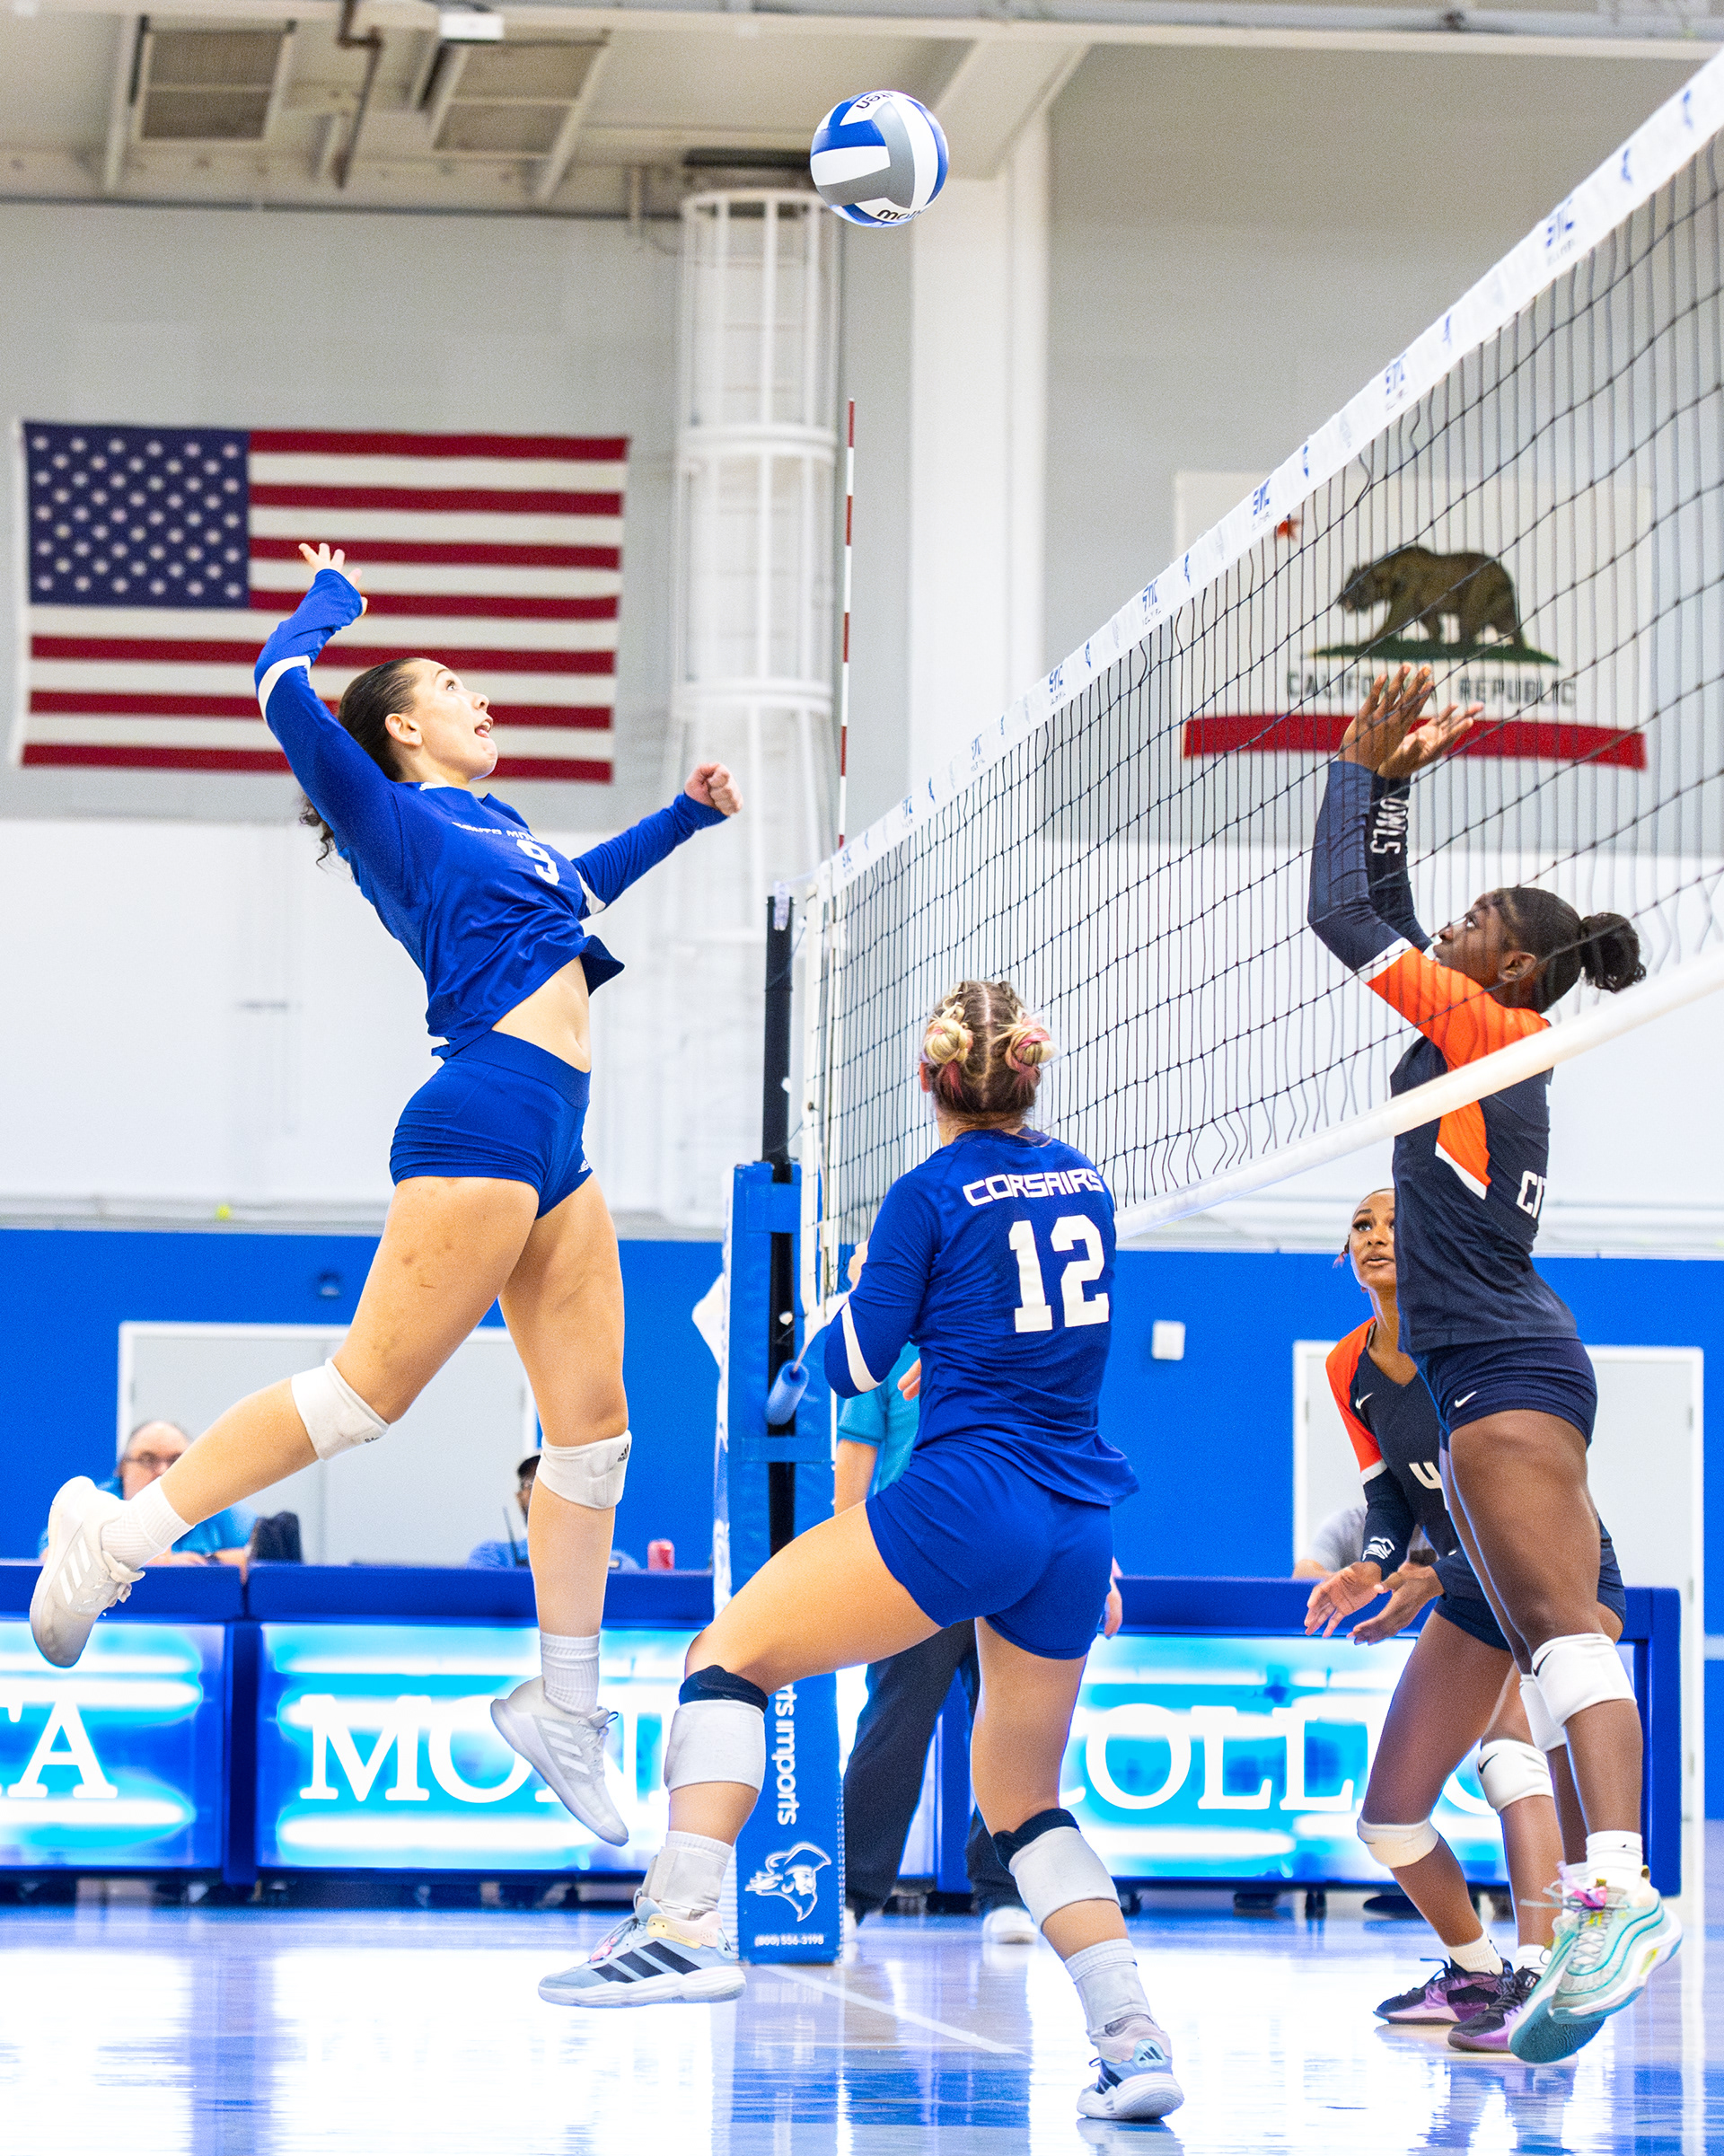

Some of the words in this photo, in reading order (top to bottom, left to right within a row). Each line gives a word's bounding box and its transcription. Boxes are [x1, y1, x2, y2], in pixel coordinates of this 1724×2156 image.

[1458, 673, 1577, 706] REPUBLIC
[1370, 797, 1409, 854] OWLS
[516, 839, 560, 886] 9
[963, 1168, 1104, 1206] CORSAIRS
[1008, 1214, 1110, 1333] 12
